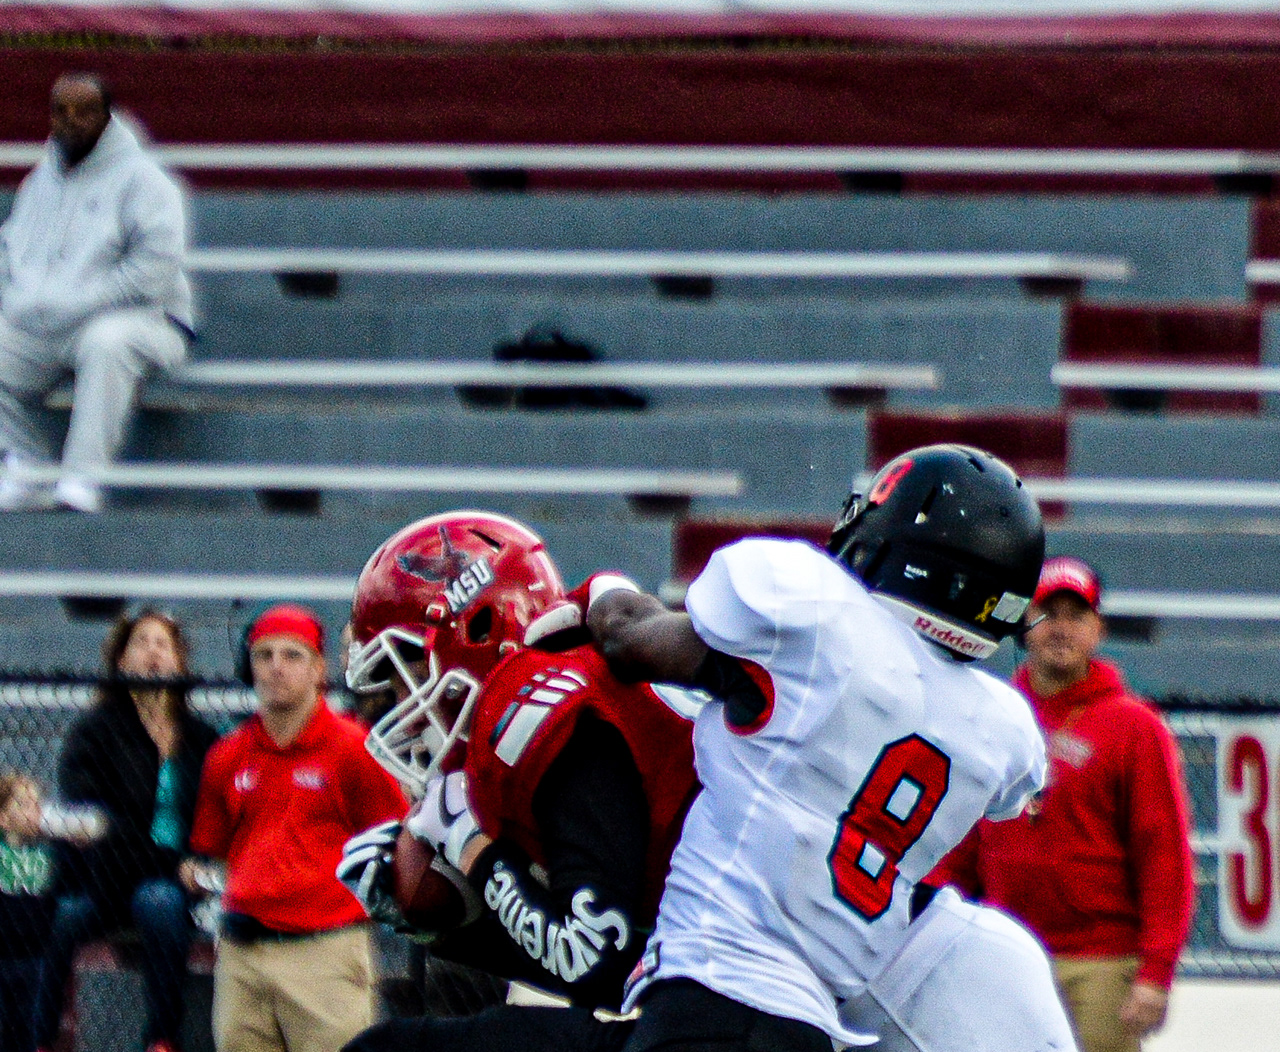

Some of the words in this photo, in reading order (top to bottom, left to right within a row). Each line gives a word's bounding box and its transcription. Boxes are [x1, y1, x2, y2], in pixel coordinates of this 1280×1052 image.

[444, 557, 494, 614] MSU
[913, 616, 986, 654] Riddell
[827, 732, 952, 924] 8
[484, 868, 630, 983] Supreme
